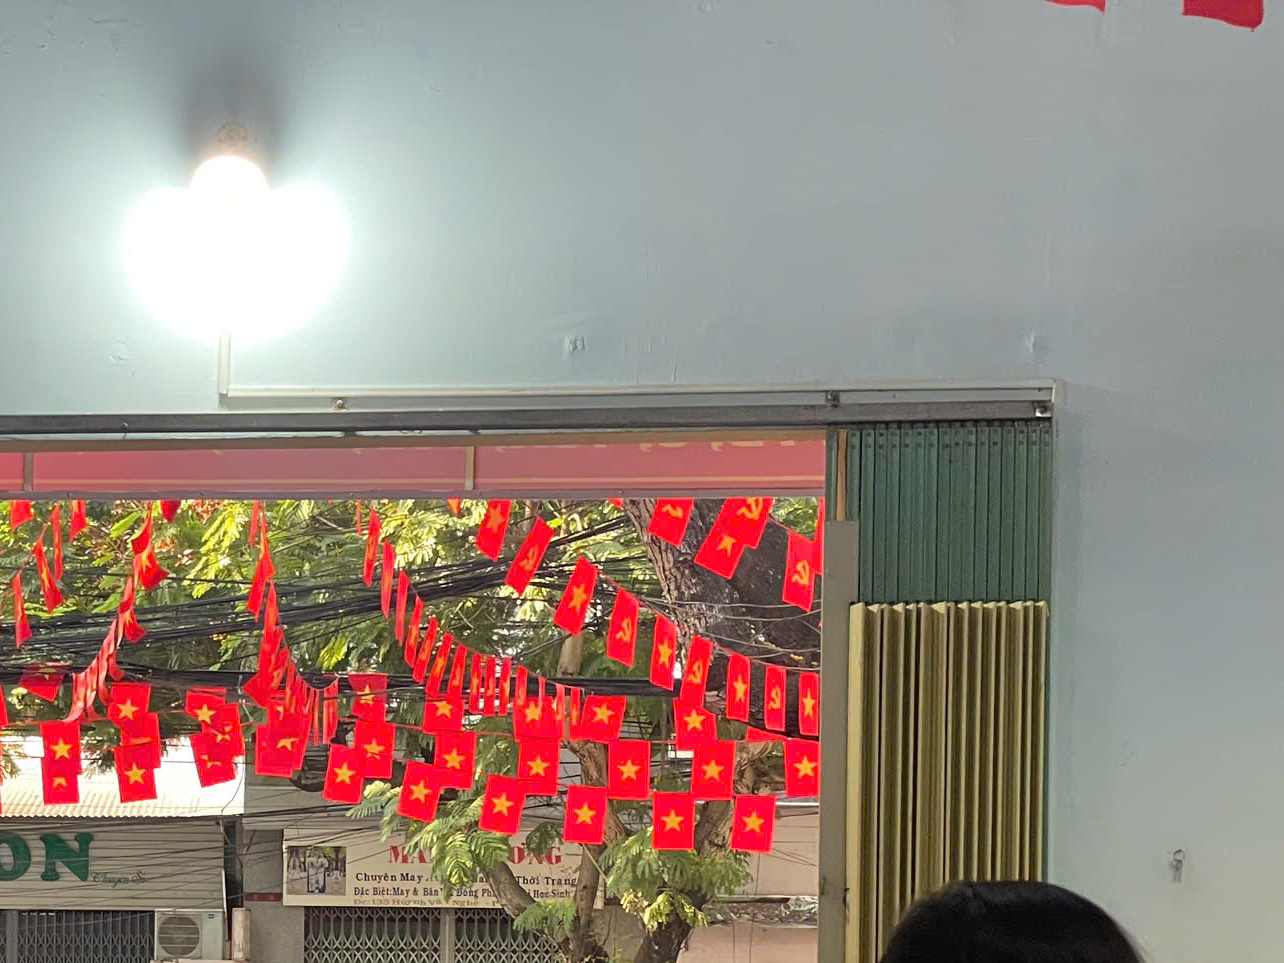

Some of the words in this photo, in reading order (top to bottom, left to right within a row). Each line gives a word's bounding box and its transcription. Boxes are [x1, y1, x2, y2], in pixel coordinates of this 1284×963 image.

[355, 872, 397, 884] Chuyên
[400, 872, 423, 884] May
[544, 876, 577, 887] Trang
[413, 887, 419, 896] &
